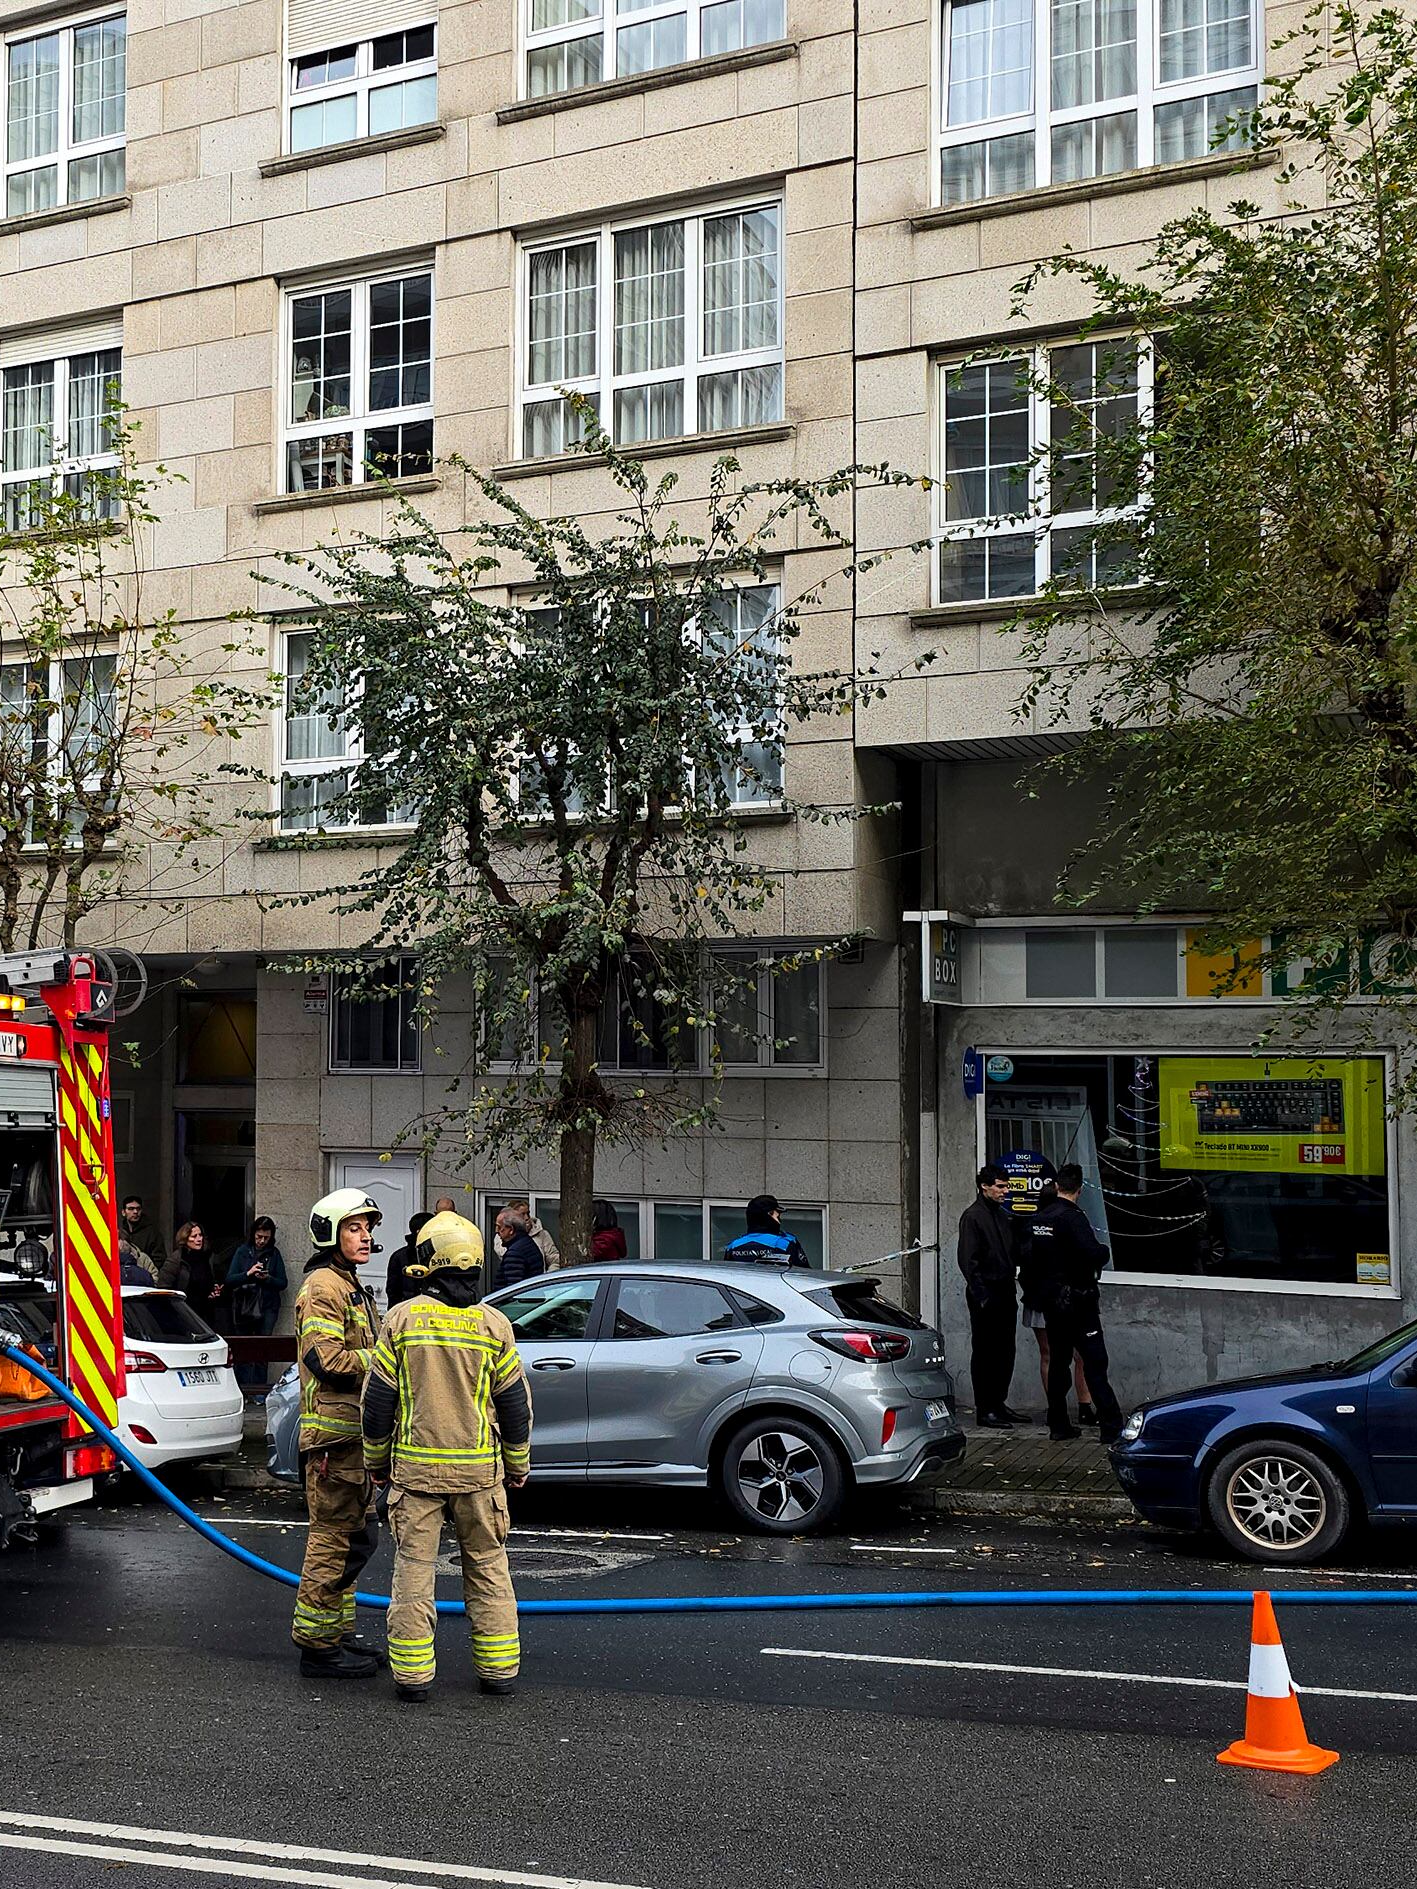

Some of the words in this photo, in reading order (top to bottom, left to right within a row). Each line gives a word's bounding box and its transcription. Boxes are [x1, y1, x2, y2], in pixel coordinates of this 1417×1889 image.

[942, 928, 957, 953] PC
[935, 958, 957, 984] BOX
[410, 1303, 484, 1320] BOMBEROS
[414, 1317, 424, 1328] A
[428, 1317, 479, 1332] CORUÑA
